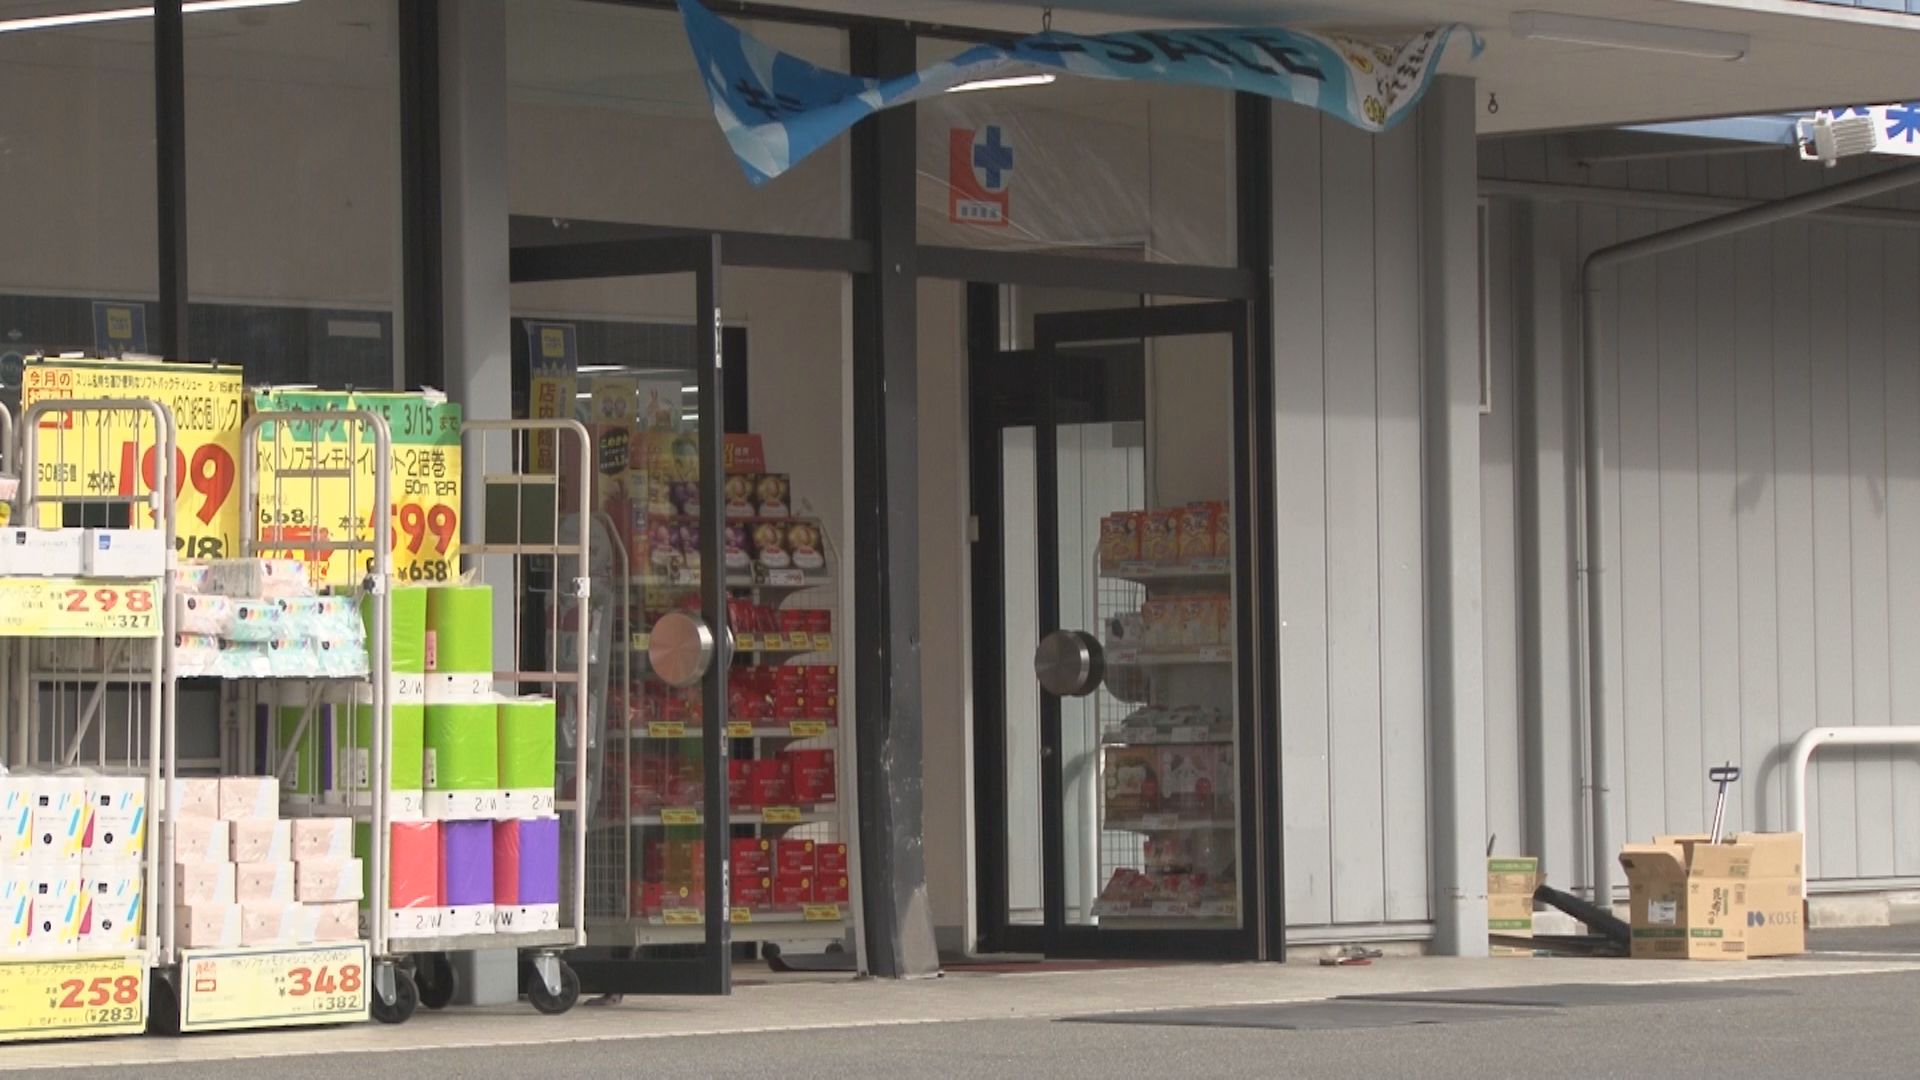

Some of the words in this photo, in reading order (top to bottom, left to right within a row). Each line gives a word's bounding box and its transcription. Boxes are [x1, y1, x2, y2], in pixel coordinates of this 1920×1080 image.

[30, 371, 71, 386] 今月の
[404, 404, 433, 436] 3/15
[439, 415, 458, 431] まで
[87, 470, 116, 493] 本体
[118, 441, 235, 527] 199
[404, 479, 429, 495] 50m
[434, 480, 457, 496] 12R
[65, 588, 153, 612] 298
[59, 975, 139, 1009] 258
[287, 965, 361, 996] 348
